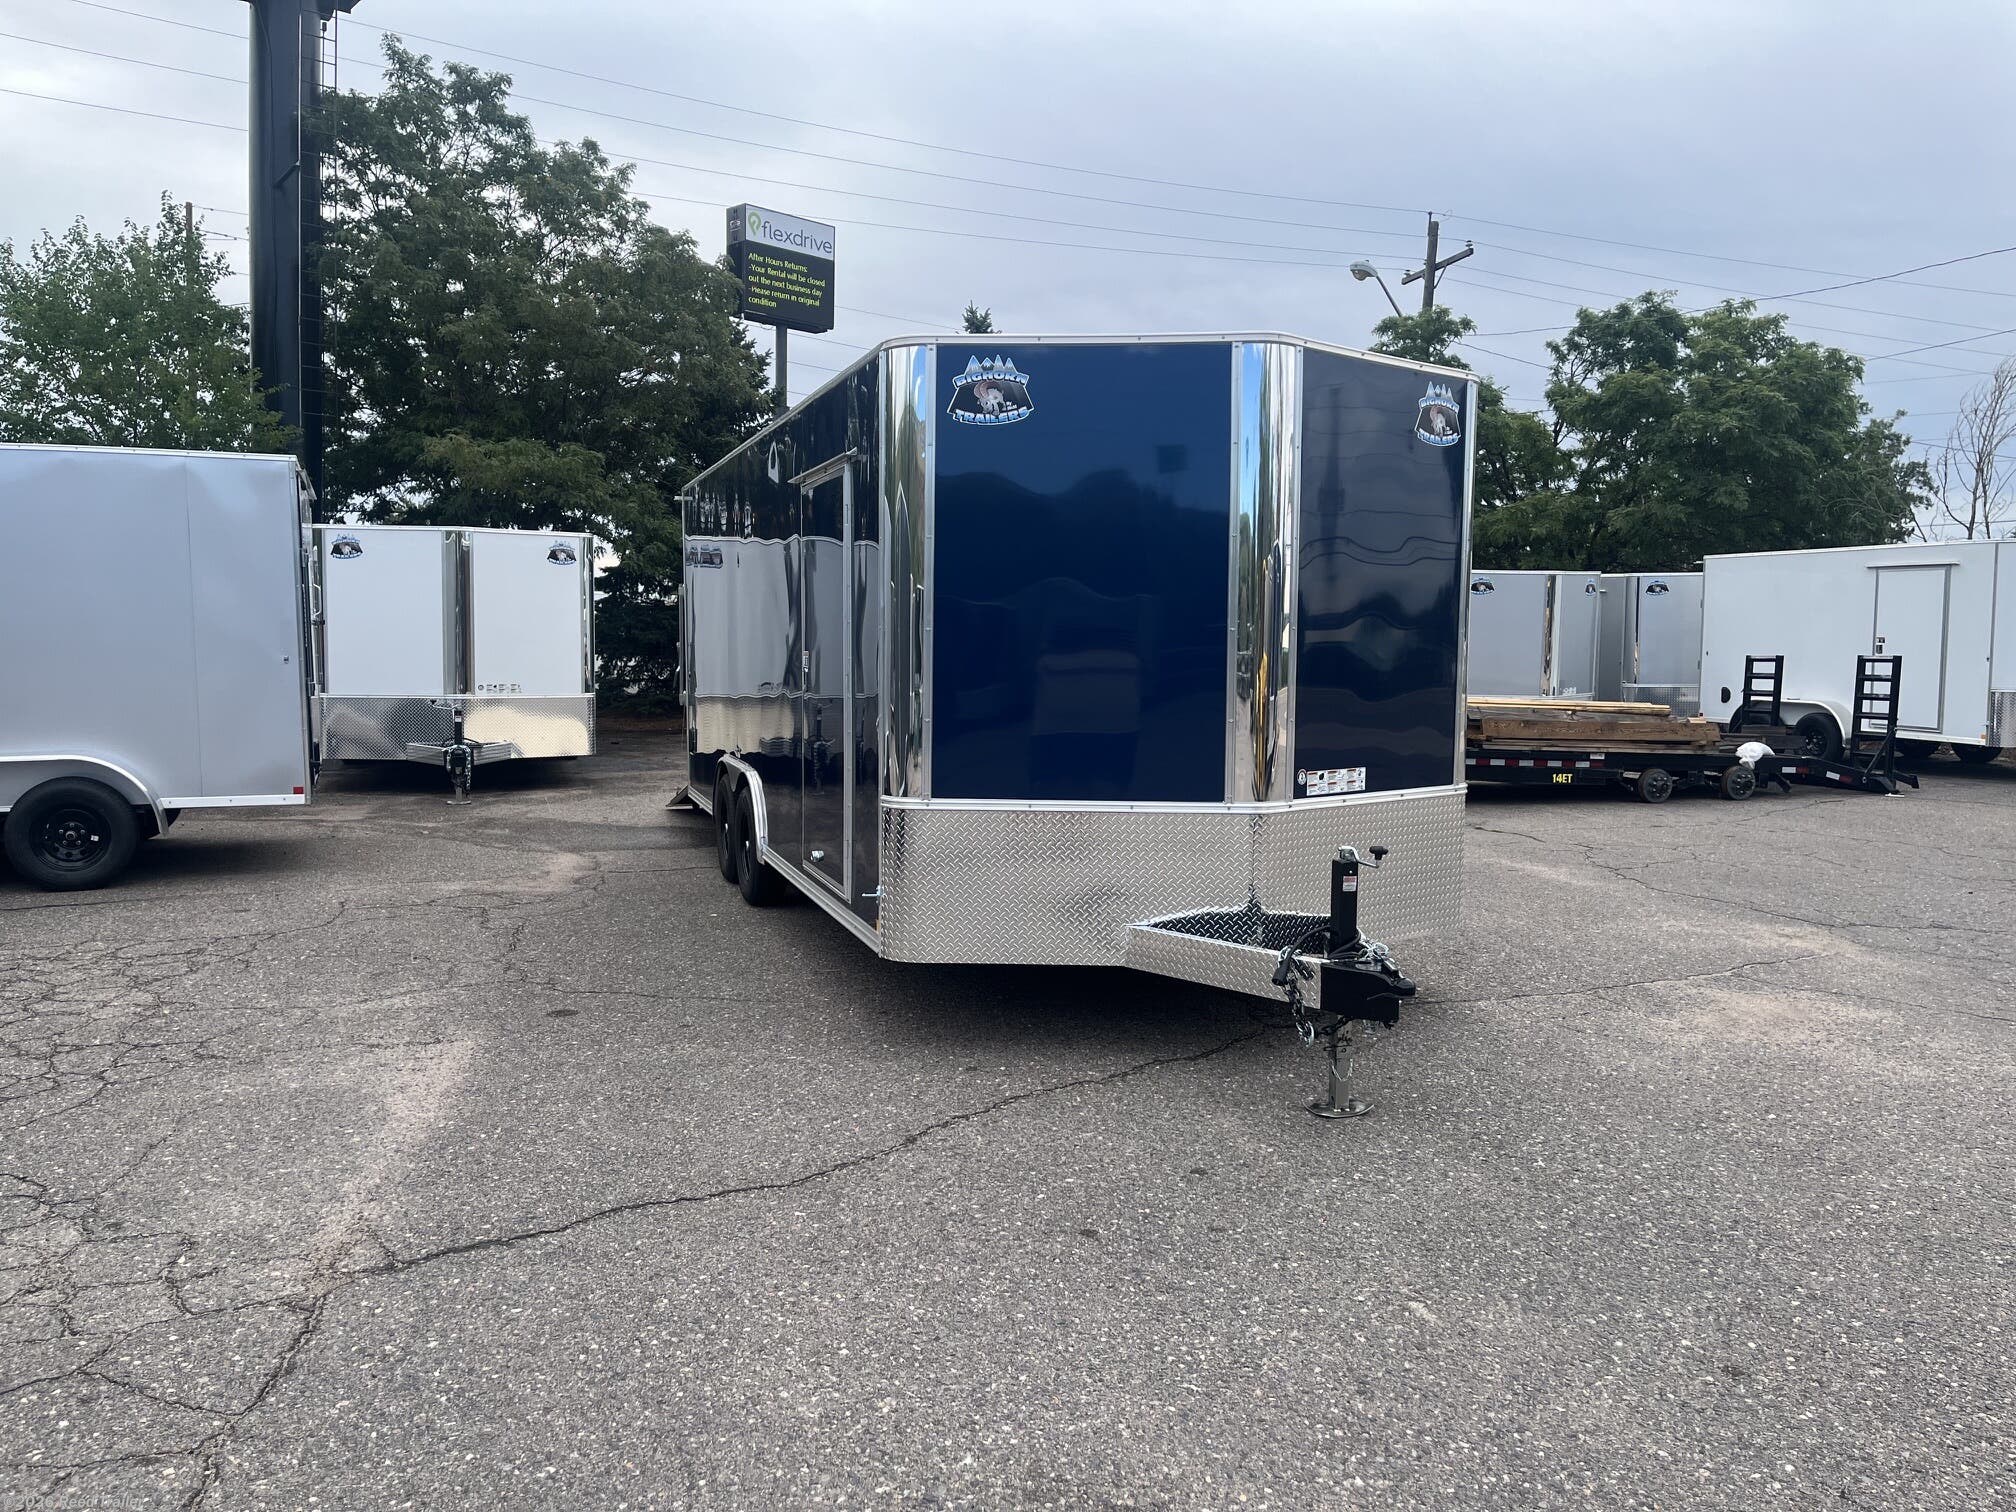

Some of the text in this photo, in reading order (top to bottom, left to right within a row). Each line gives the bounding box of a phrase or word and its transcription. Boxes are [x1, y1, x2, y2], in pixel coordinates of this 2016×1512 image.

[761, 221, 832, 254] flexdrive
[748, 253, 764, 262] After
[765, 257, 783, 266] Hours
[748, 275, 822, 297] out the next business day
[767, 268, 786, 278] Rental
[787, 273, 797, 281] will
[798, 274, 806, 282] be
[807, 277, 825, 287] closed
[748, 296, 777, 308] condition
[771, 290, 790, 300] return
[798, 296, 819, 306] original
[955, 406, 1030, 423] TRAILERS
[1419, 427, 1459, 445] TRAILERS
[1552, 773, 1573, 784] 14ET
